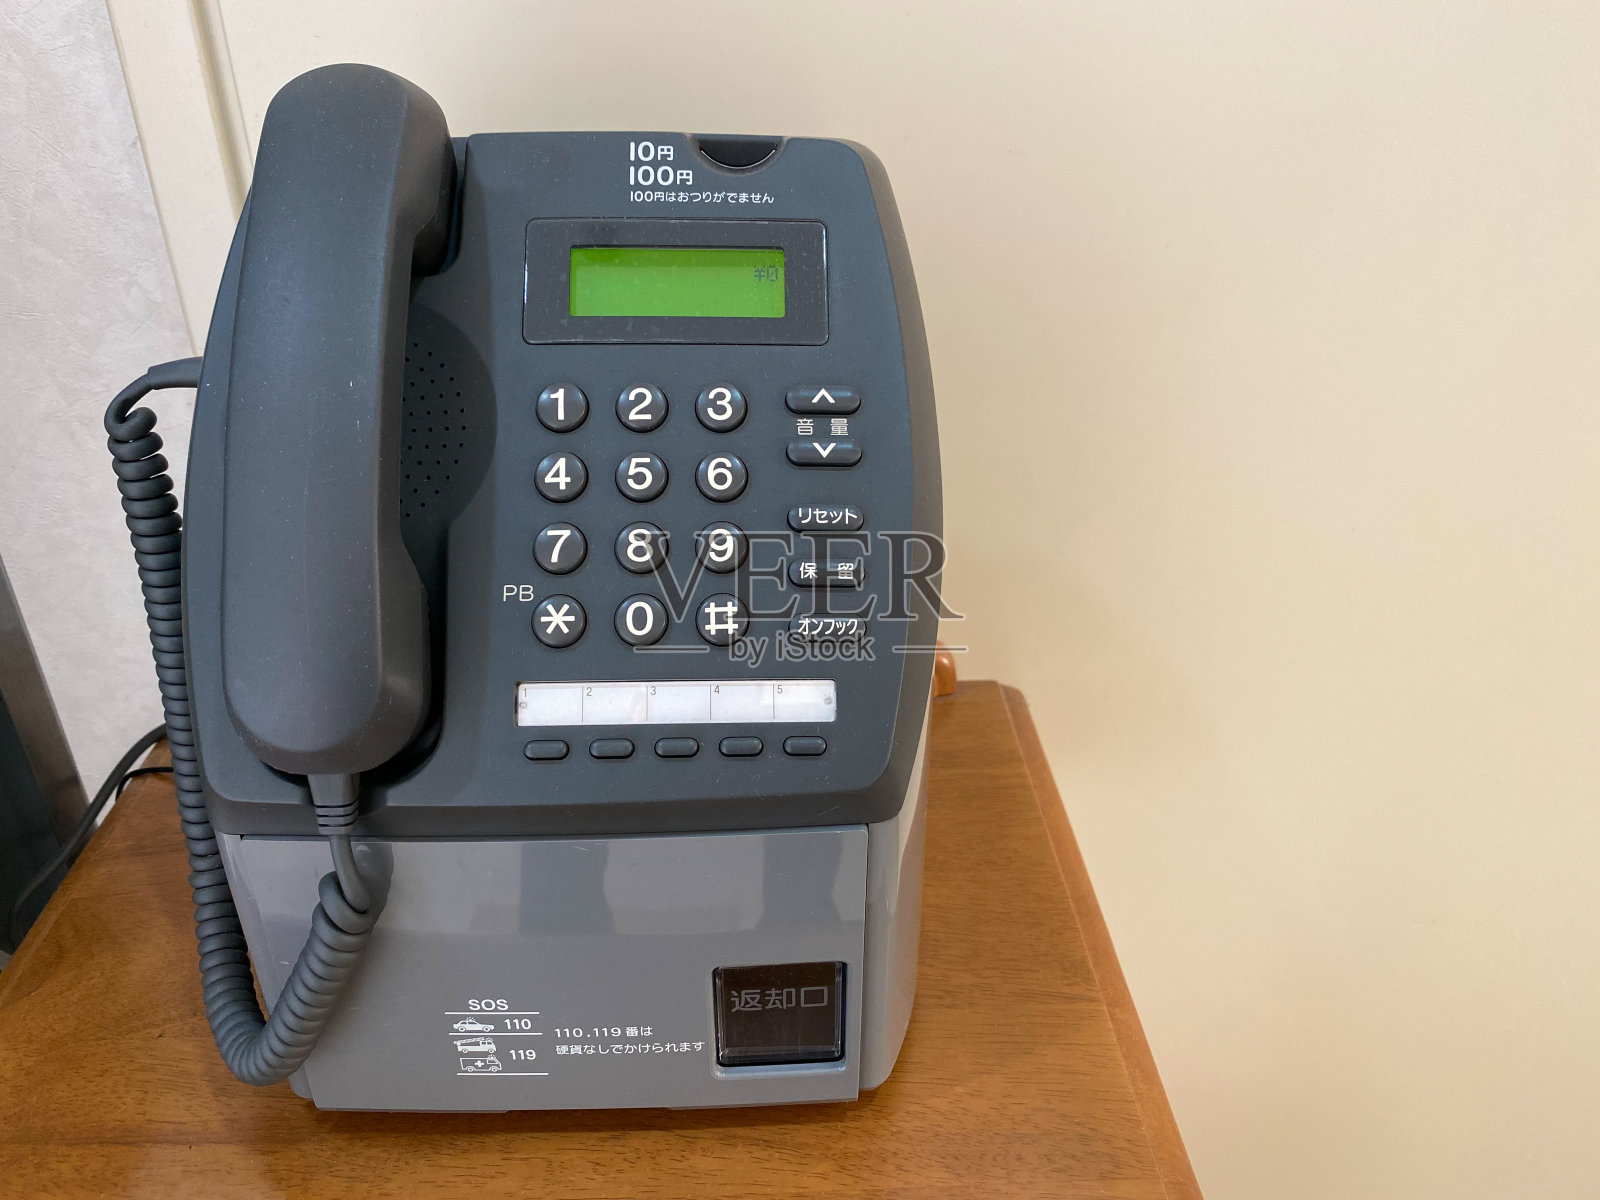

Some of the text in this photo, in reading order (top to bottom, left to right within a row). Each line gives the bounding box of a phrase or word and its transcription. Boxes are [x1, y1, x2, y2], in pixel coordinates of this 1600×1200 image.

[629, 141, 674, 161] 10円
[629, 165, 693, 186] 100円
[630, 191, 775, 204] 100円はおつりがでません
[549, 388, 565, 420] 1
[628, 388, 652, 420] 2
[707, 388, 733, 420] 3
[544, 457, 571, 490] 4
[626, 457, 653, 490] 5
[707, 457, 733, 490] 6
[798, 507, 857, 524] リセット
[546, 529, 571, 563] 7
[626, 528, 653, 562] 8
[708, 528, 734, 562] 9
[503, 584, 534, 602] PB
[626, 601, 654, 636] 0
[797, 617, 858, 636] オンフック
[586, 687, 592, 697] 2
[650, 686, 657, 696] 3
[713, 685, 720, 695] 4
[777, 684, 783, 695] 5
[468, 998, 509, 1012] SOS
[731, 986, 829, 1013] 返却口
[504, 1018, 532, 1031] 110
[509, 1049, 537, 1062] 119
[555, 1041, 705, 1055] 硬貨なしでかけられます
